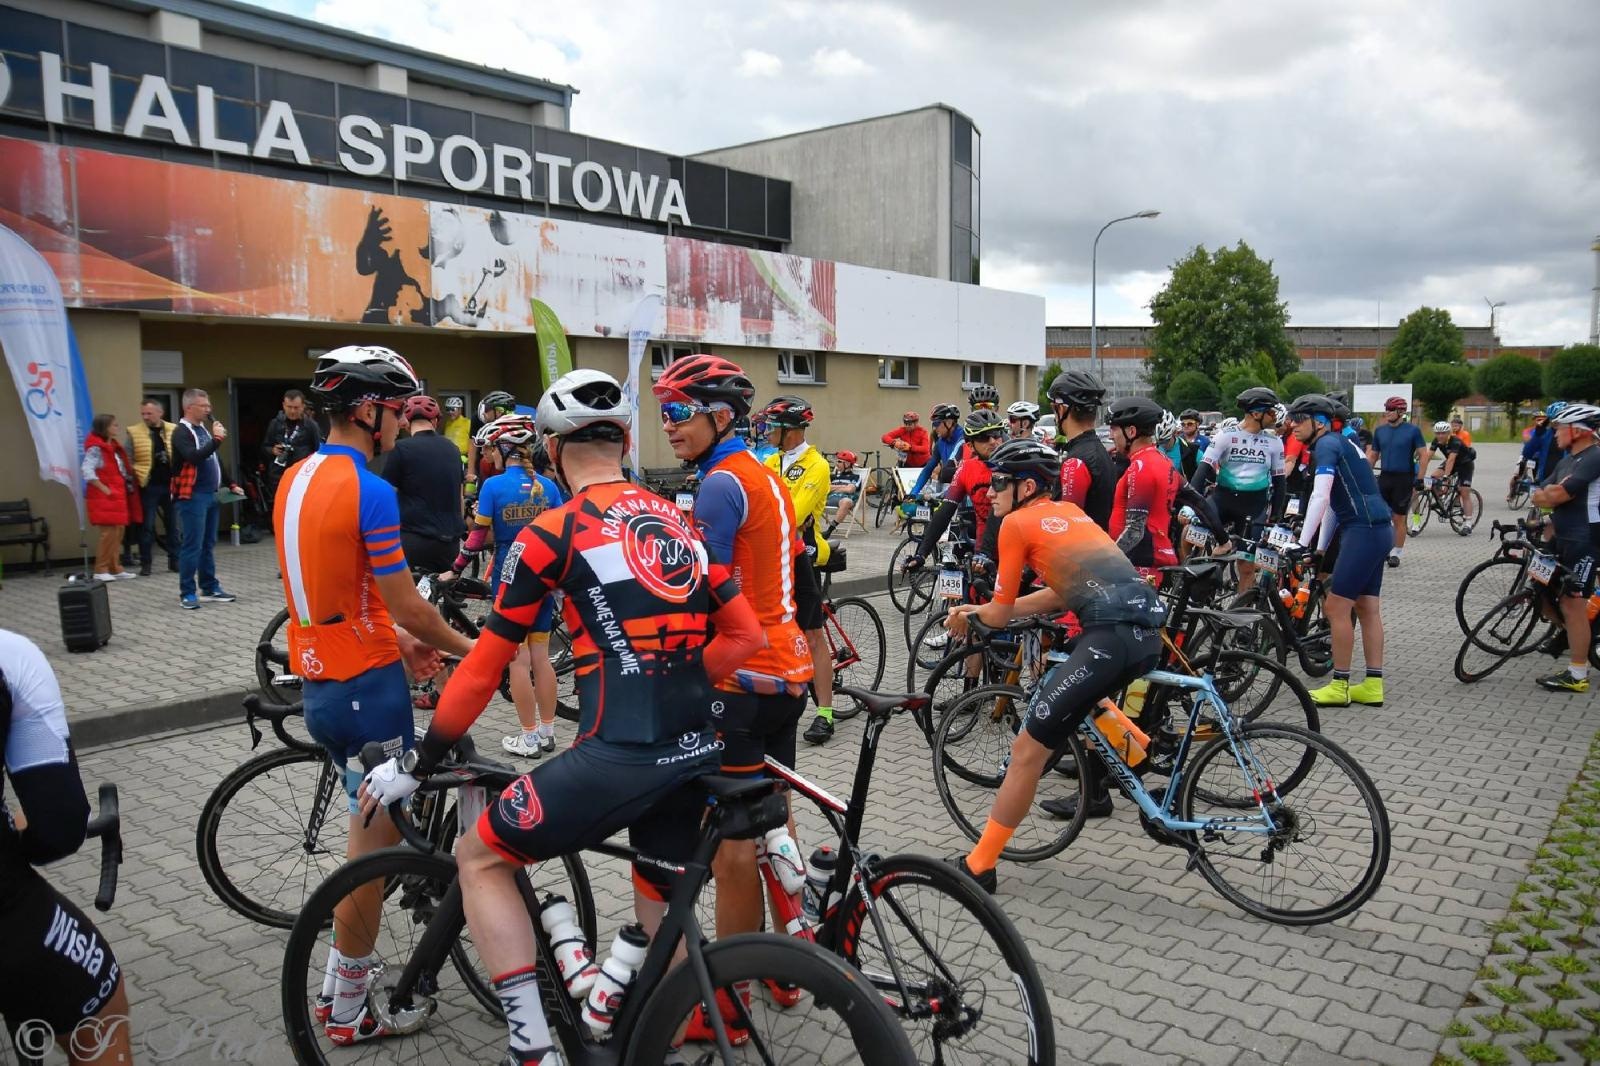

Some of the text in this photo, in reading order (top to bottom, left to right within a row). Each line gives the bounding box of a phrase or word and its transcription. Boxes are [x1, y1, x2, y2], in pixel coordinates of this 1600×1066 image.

[40, 51, 692, 226] HALA SPORTOWA
[1230, 447, 1266, 457] BORA
[626, 498, 650, 511] NA
[941, 578, 961, 589] 1436
[602, 620, 622, 640] NA
[1048, 665, 1090, 702] INNERGY
[1079, 719, 1137, 791] nondale
[44, 903, 105, 979] Wisła
